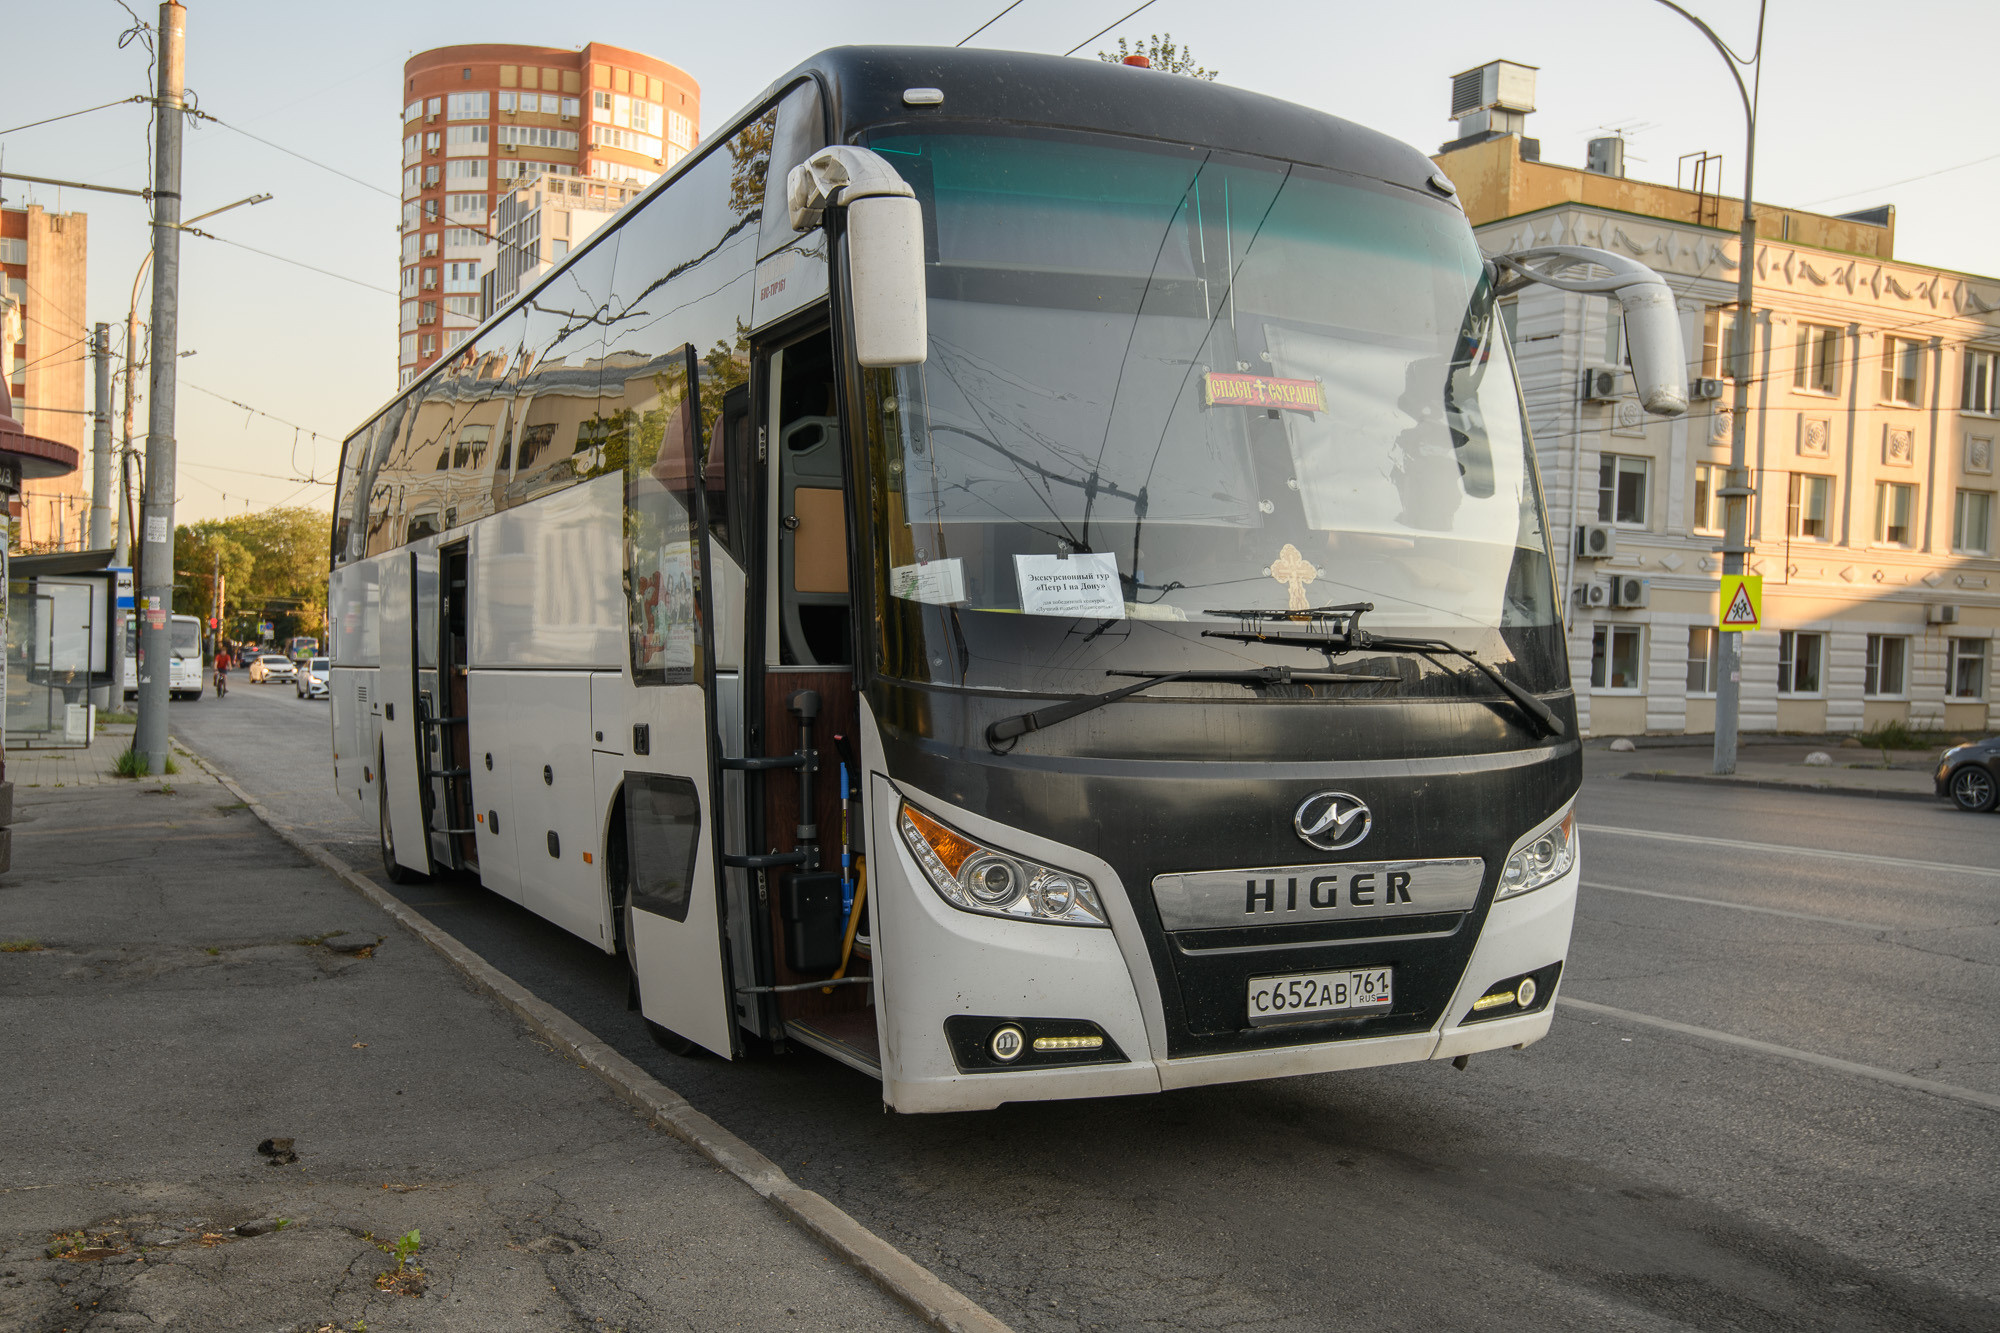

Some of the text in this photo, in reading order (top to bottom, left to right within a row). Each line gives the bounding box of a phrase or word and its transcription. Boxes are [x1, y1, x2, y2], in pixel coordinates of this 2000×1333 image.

[1212, 379, 1318, 405] СПАСИ СОХРАНИ
[0, 468, 11, 484] /3
[1028, 573, 1110, 583] Экскурсионный тур
[1036, 583, 1061, 592] «Петр
[1081, 582, 1106, 591] Дону»
[1245, 872, 1412, 915] HIGER
[1353, 972, 1386, 995] 761
[1359, 994, 1376, 1003] RUS
